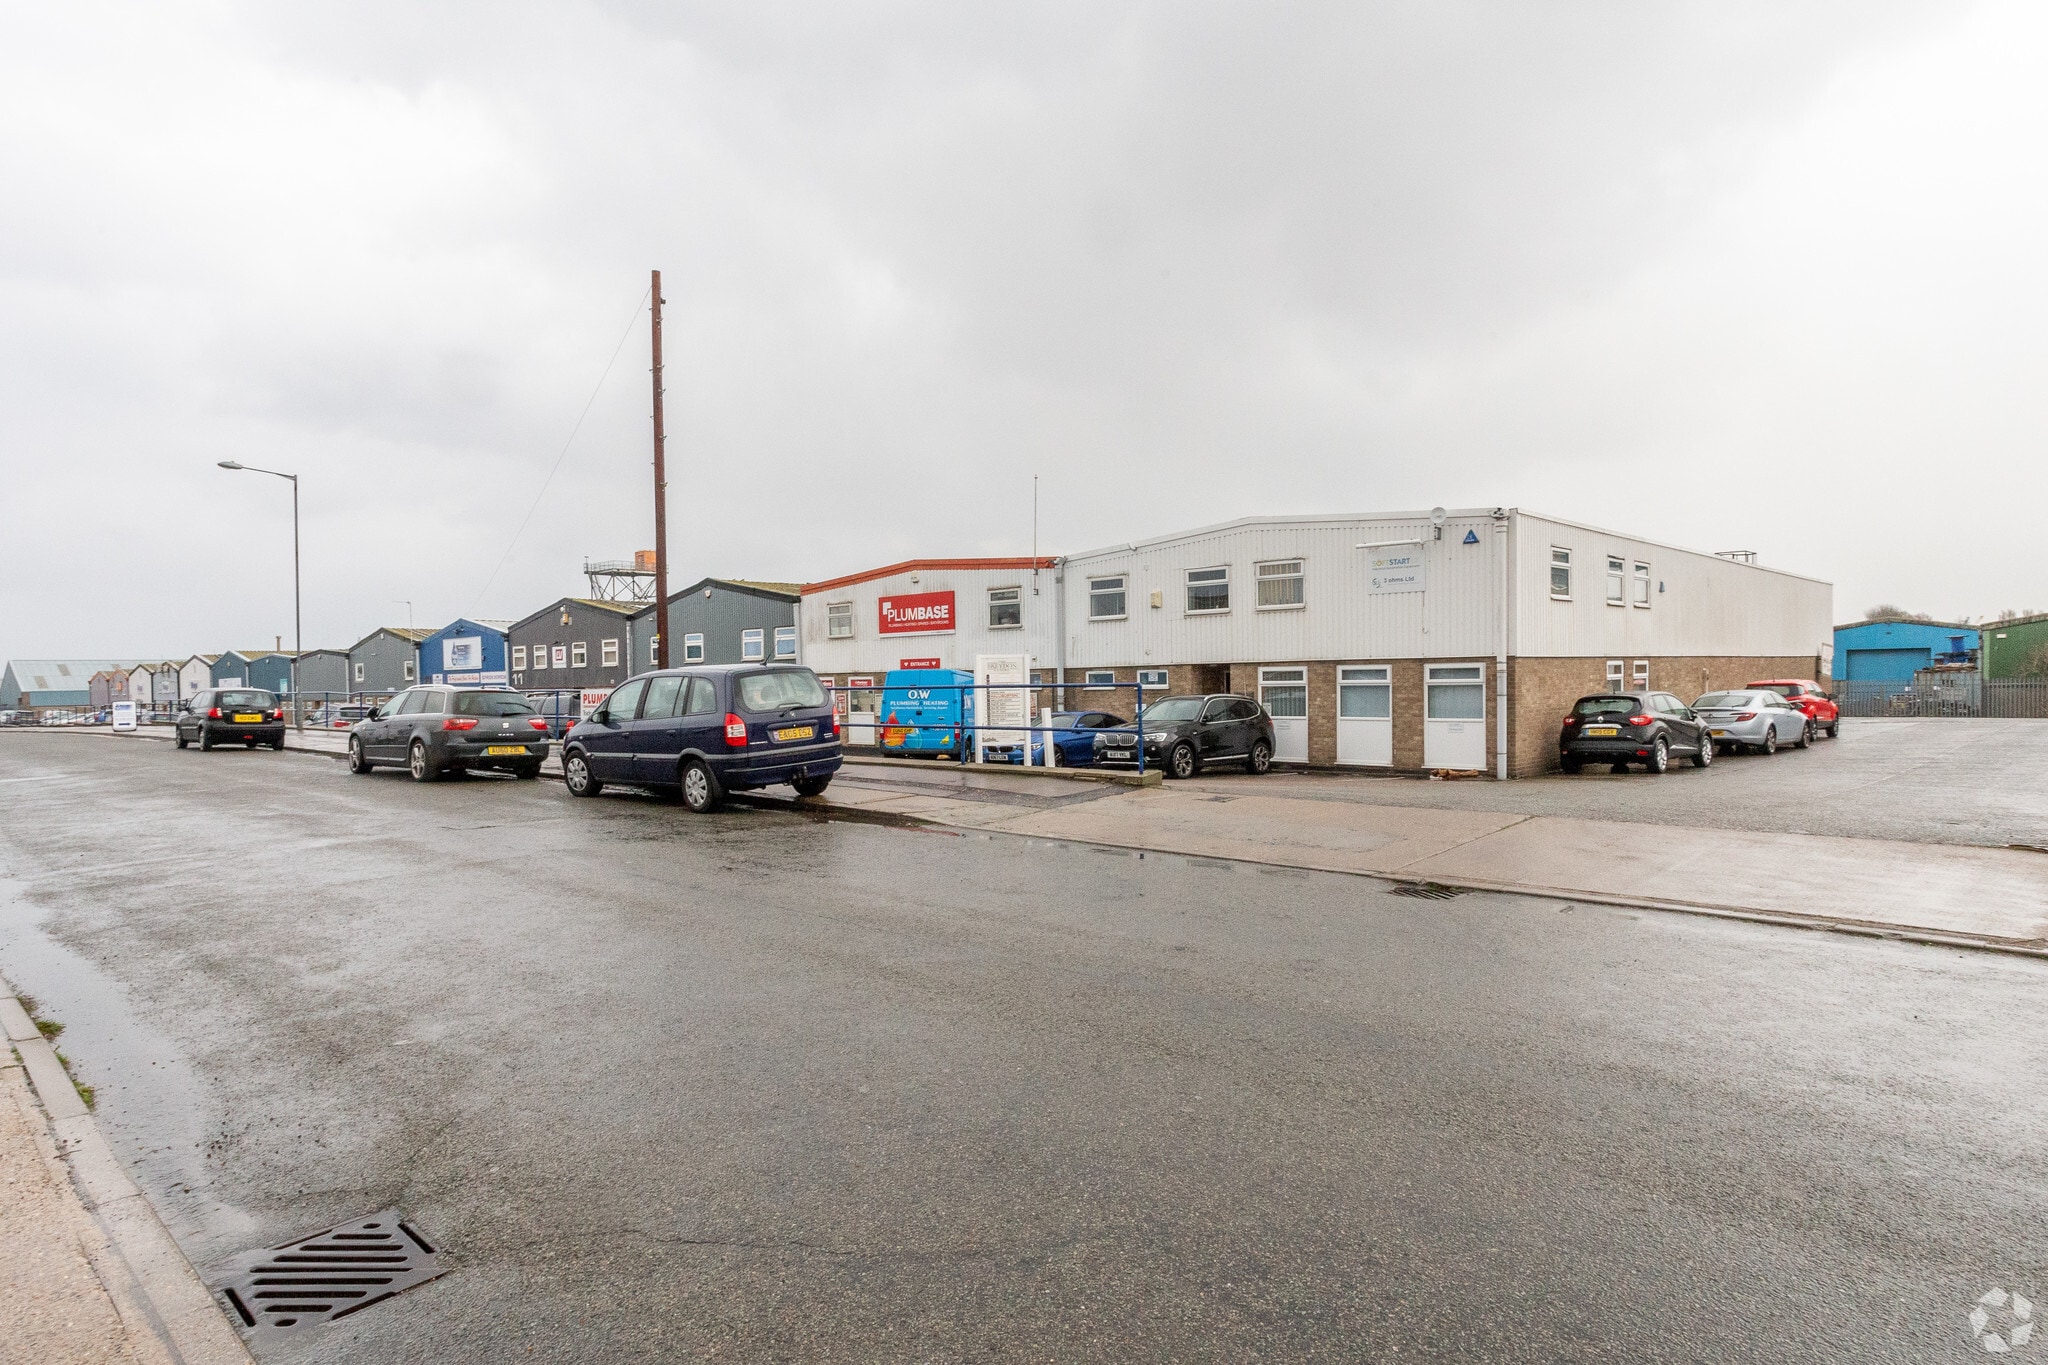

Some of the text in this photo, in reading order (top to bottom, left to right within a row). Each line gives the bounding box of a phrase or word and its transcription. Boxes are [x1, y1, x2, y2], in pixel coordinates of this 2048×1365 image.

[888, 605, 949, 622] PLUMBASE
[512, 673, 523, 685] 11
[908, 690, 930, 699] O.W
